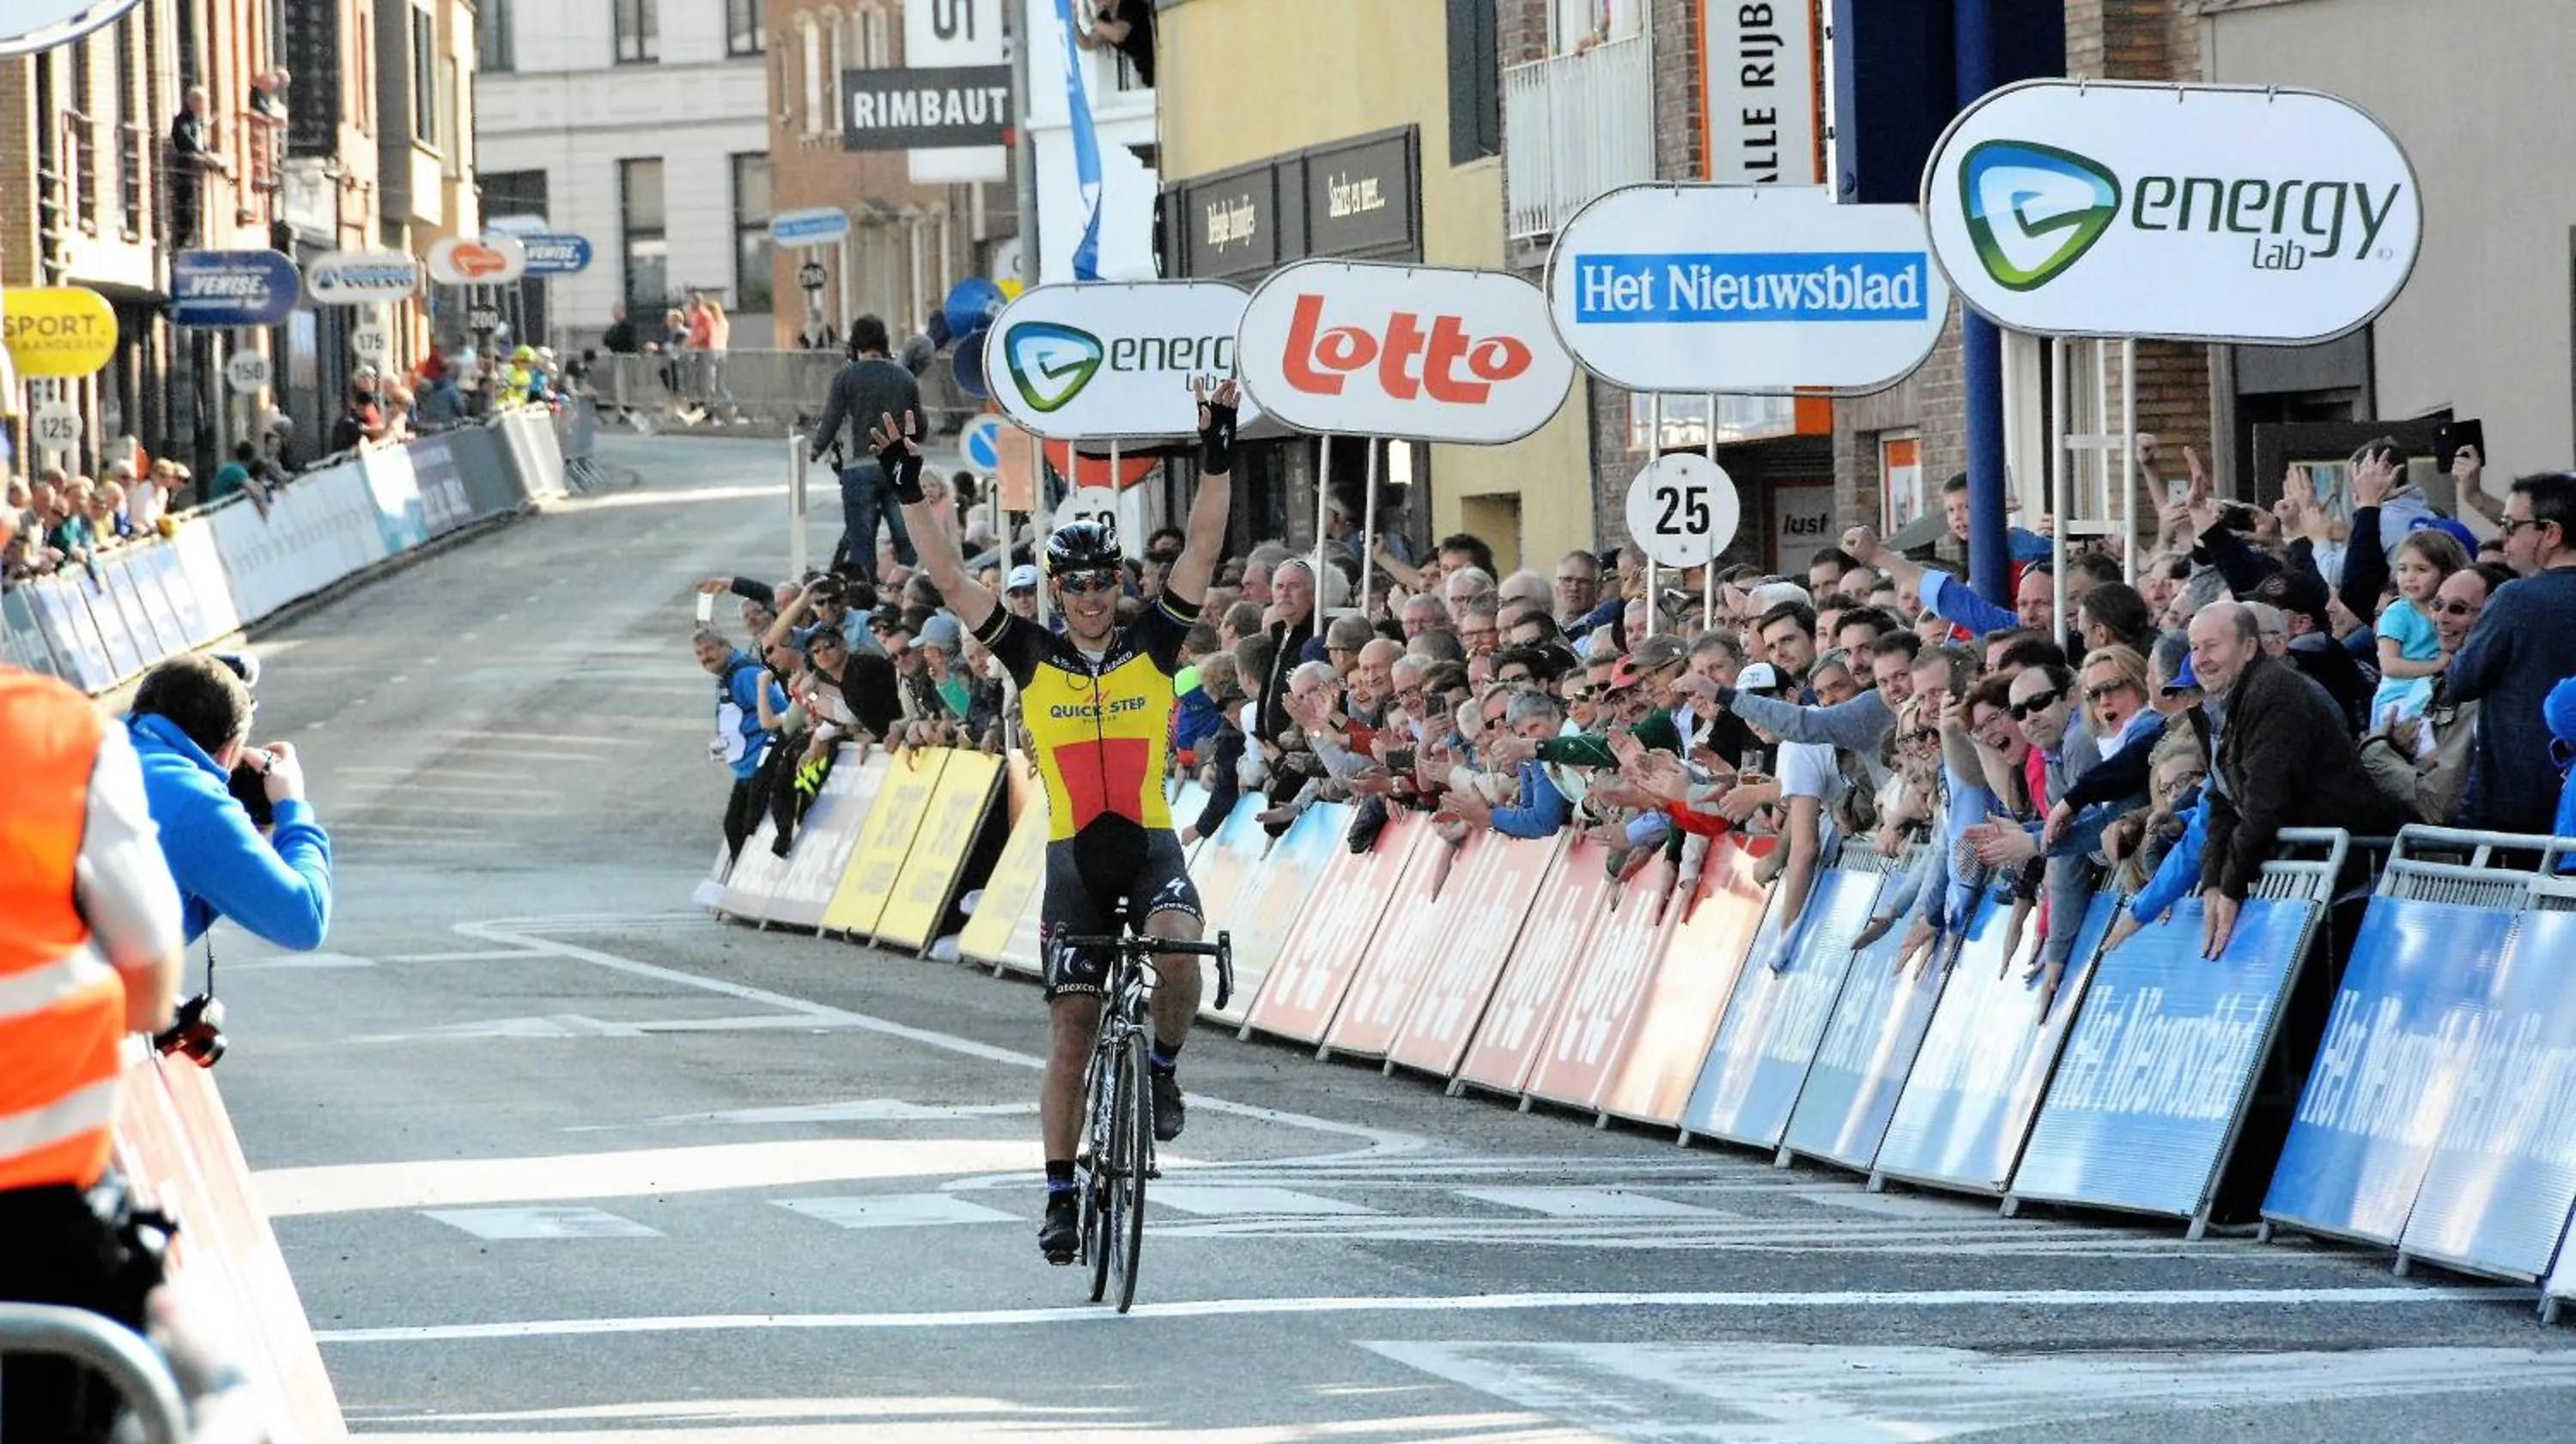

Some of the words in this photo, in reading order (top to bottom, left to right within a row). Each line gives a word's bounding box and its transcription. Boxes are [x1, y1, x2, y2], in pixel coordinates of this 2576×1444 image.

[854, 87, 1008, 128] RIMBAUT
[2131, 176, 2401, 260] energy
[2252, 237, 2306, 270] lab
[190, 275, 264, 295] VENISE
[1582, 264, 1656, 312] Het
[1667, 262, 1921, 312] Nieuwsblad
[358, 332, 384, 351] 175
[1111, 336, 1237, 380] energ
[234, 362, 264, 380] 150
[42, 416, 74, 439] 125
[1656, 486, 1710, 535] 25
[1049, 704, 1103, 719] QUICK
[1109, 696, 1145, 713] STEP
